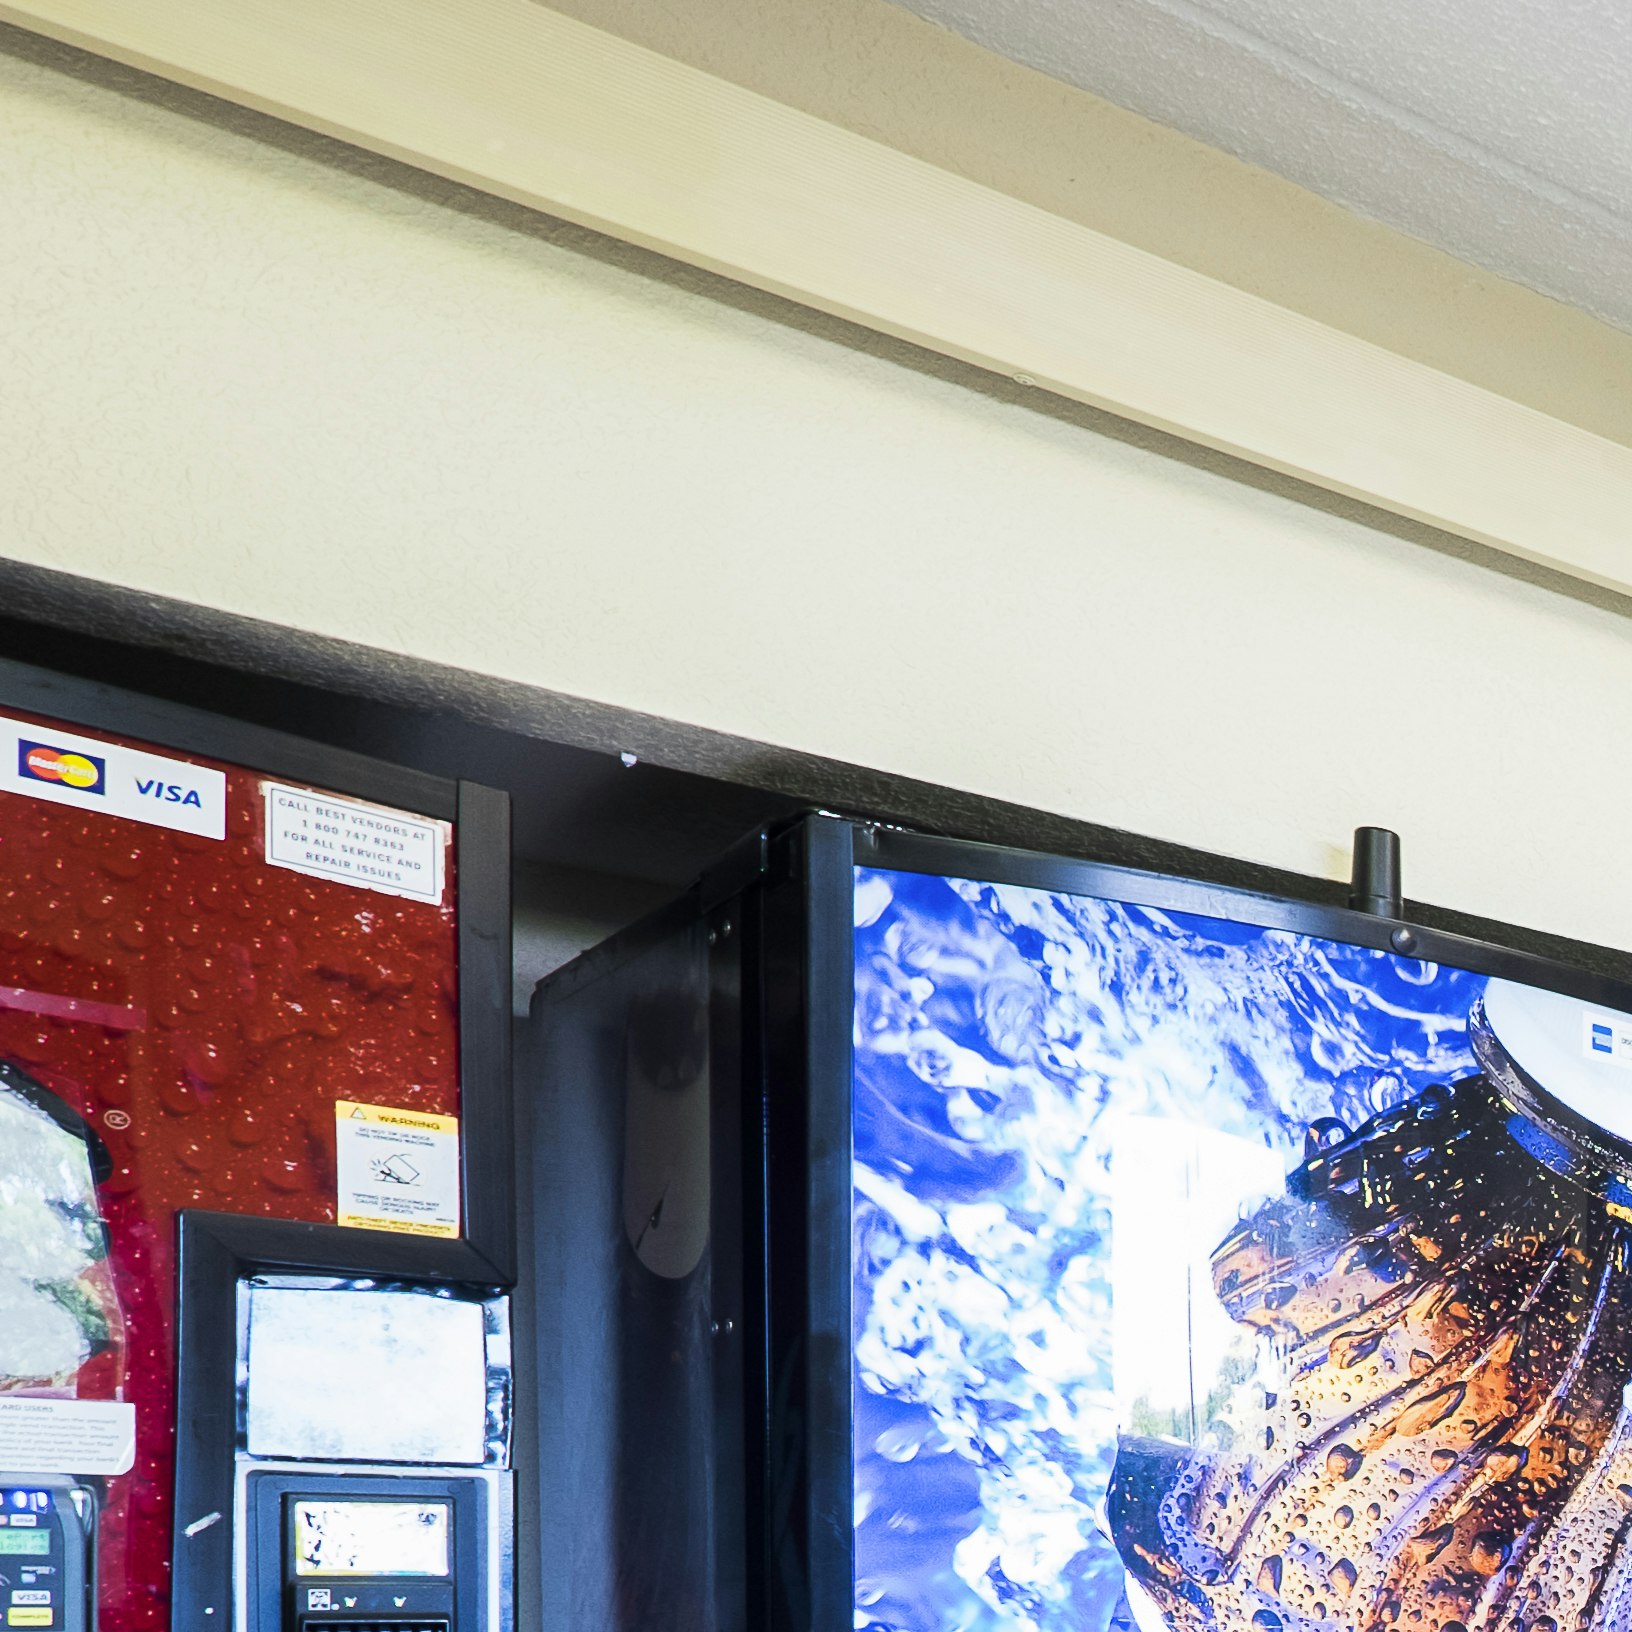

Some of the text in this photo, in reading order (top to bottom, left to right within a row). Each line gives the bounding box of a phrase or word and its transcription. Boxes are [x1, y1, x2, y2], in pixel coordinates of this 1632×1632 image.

[135, 777, 202, 808] VISA
[278, 797, 310, 813] CALL
[316, 807, 346, 821] BEST
[350, 816, 408, 837] VENDORS
[284, 830, 422, 871] FOR ALL SERVICE AND
[305, 852, 402, 881] REPAIR ISSUES
[16, 1593, 48, 1602] VISA
